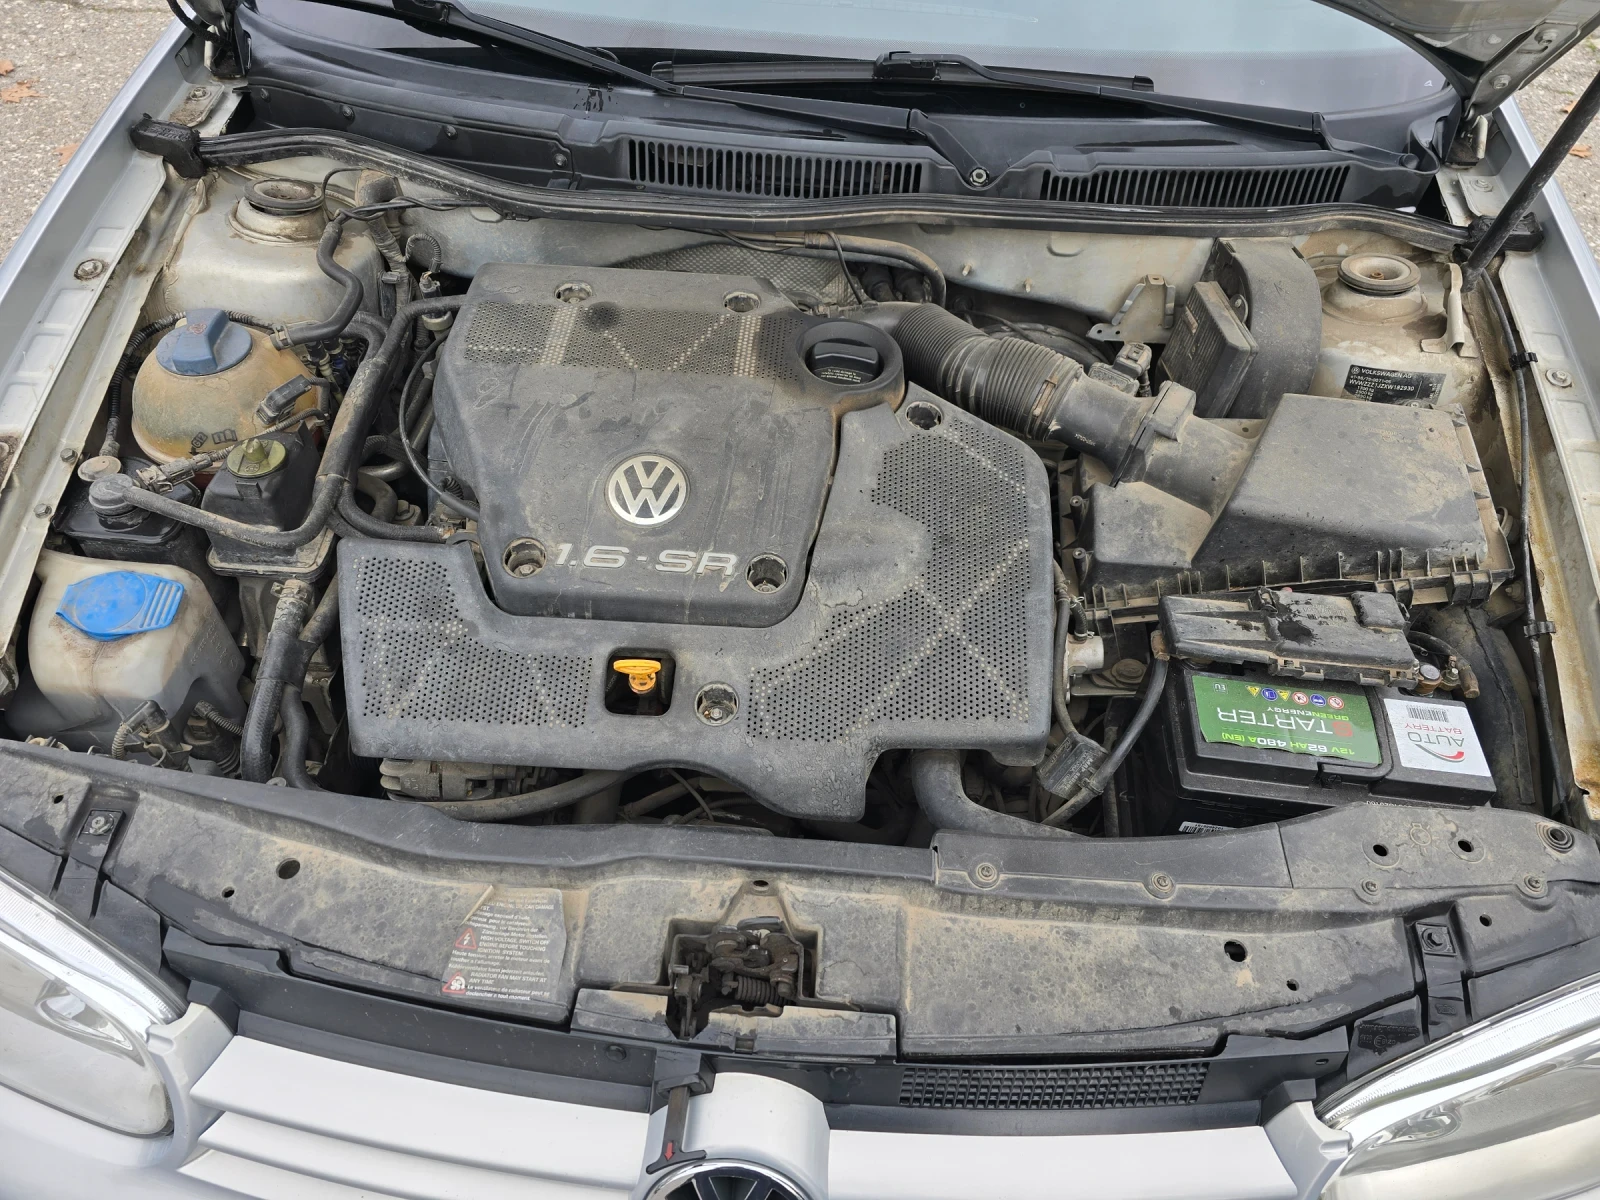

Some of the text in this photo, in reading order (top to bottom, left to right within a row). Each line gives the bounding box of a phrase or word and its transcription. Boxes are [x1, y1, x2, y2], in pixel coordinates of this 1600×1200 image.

[1361, 368, 1402, 378] VOLKSWAGEN
[1214, 683, 1227, 691] EU
[1267, 706, 1350, 721] GREENENERGY
[1217, 706, 1353, 737] STARTER
[1404, 723, 1462, 734] BATTERY
[1222, 732, 1355, 755] 12V 62AH 480A (EN)
[1408, 732, 1464, 748] AUTO
[470, 971, 498, 979] RADIATOR
